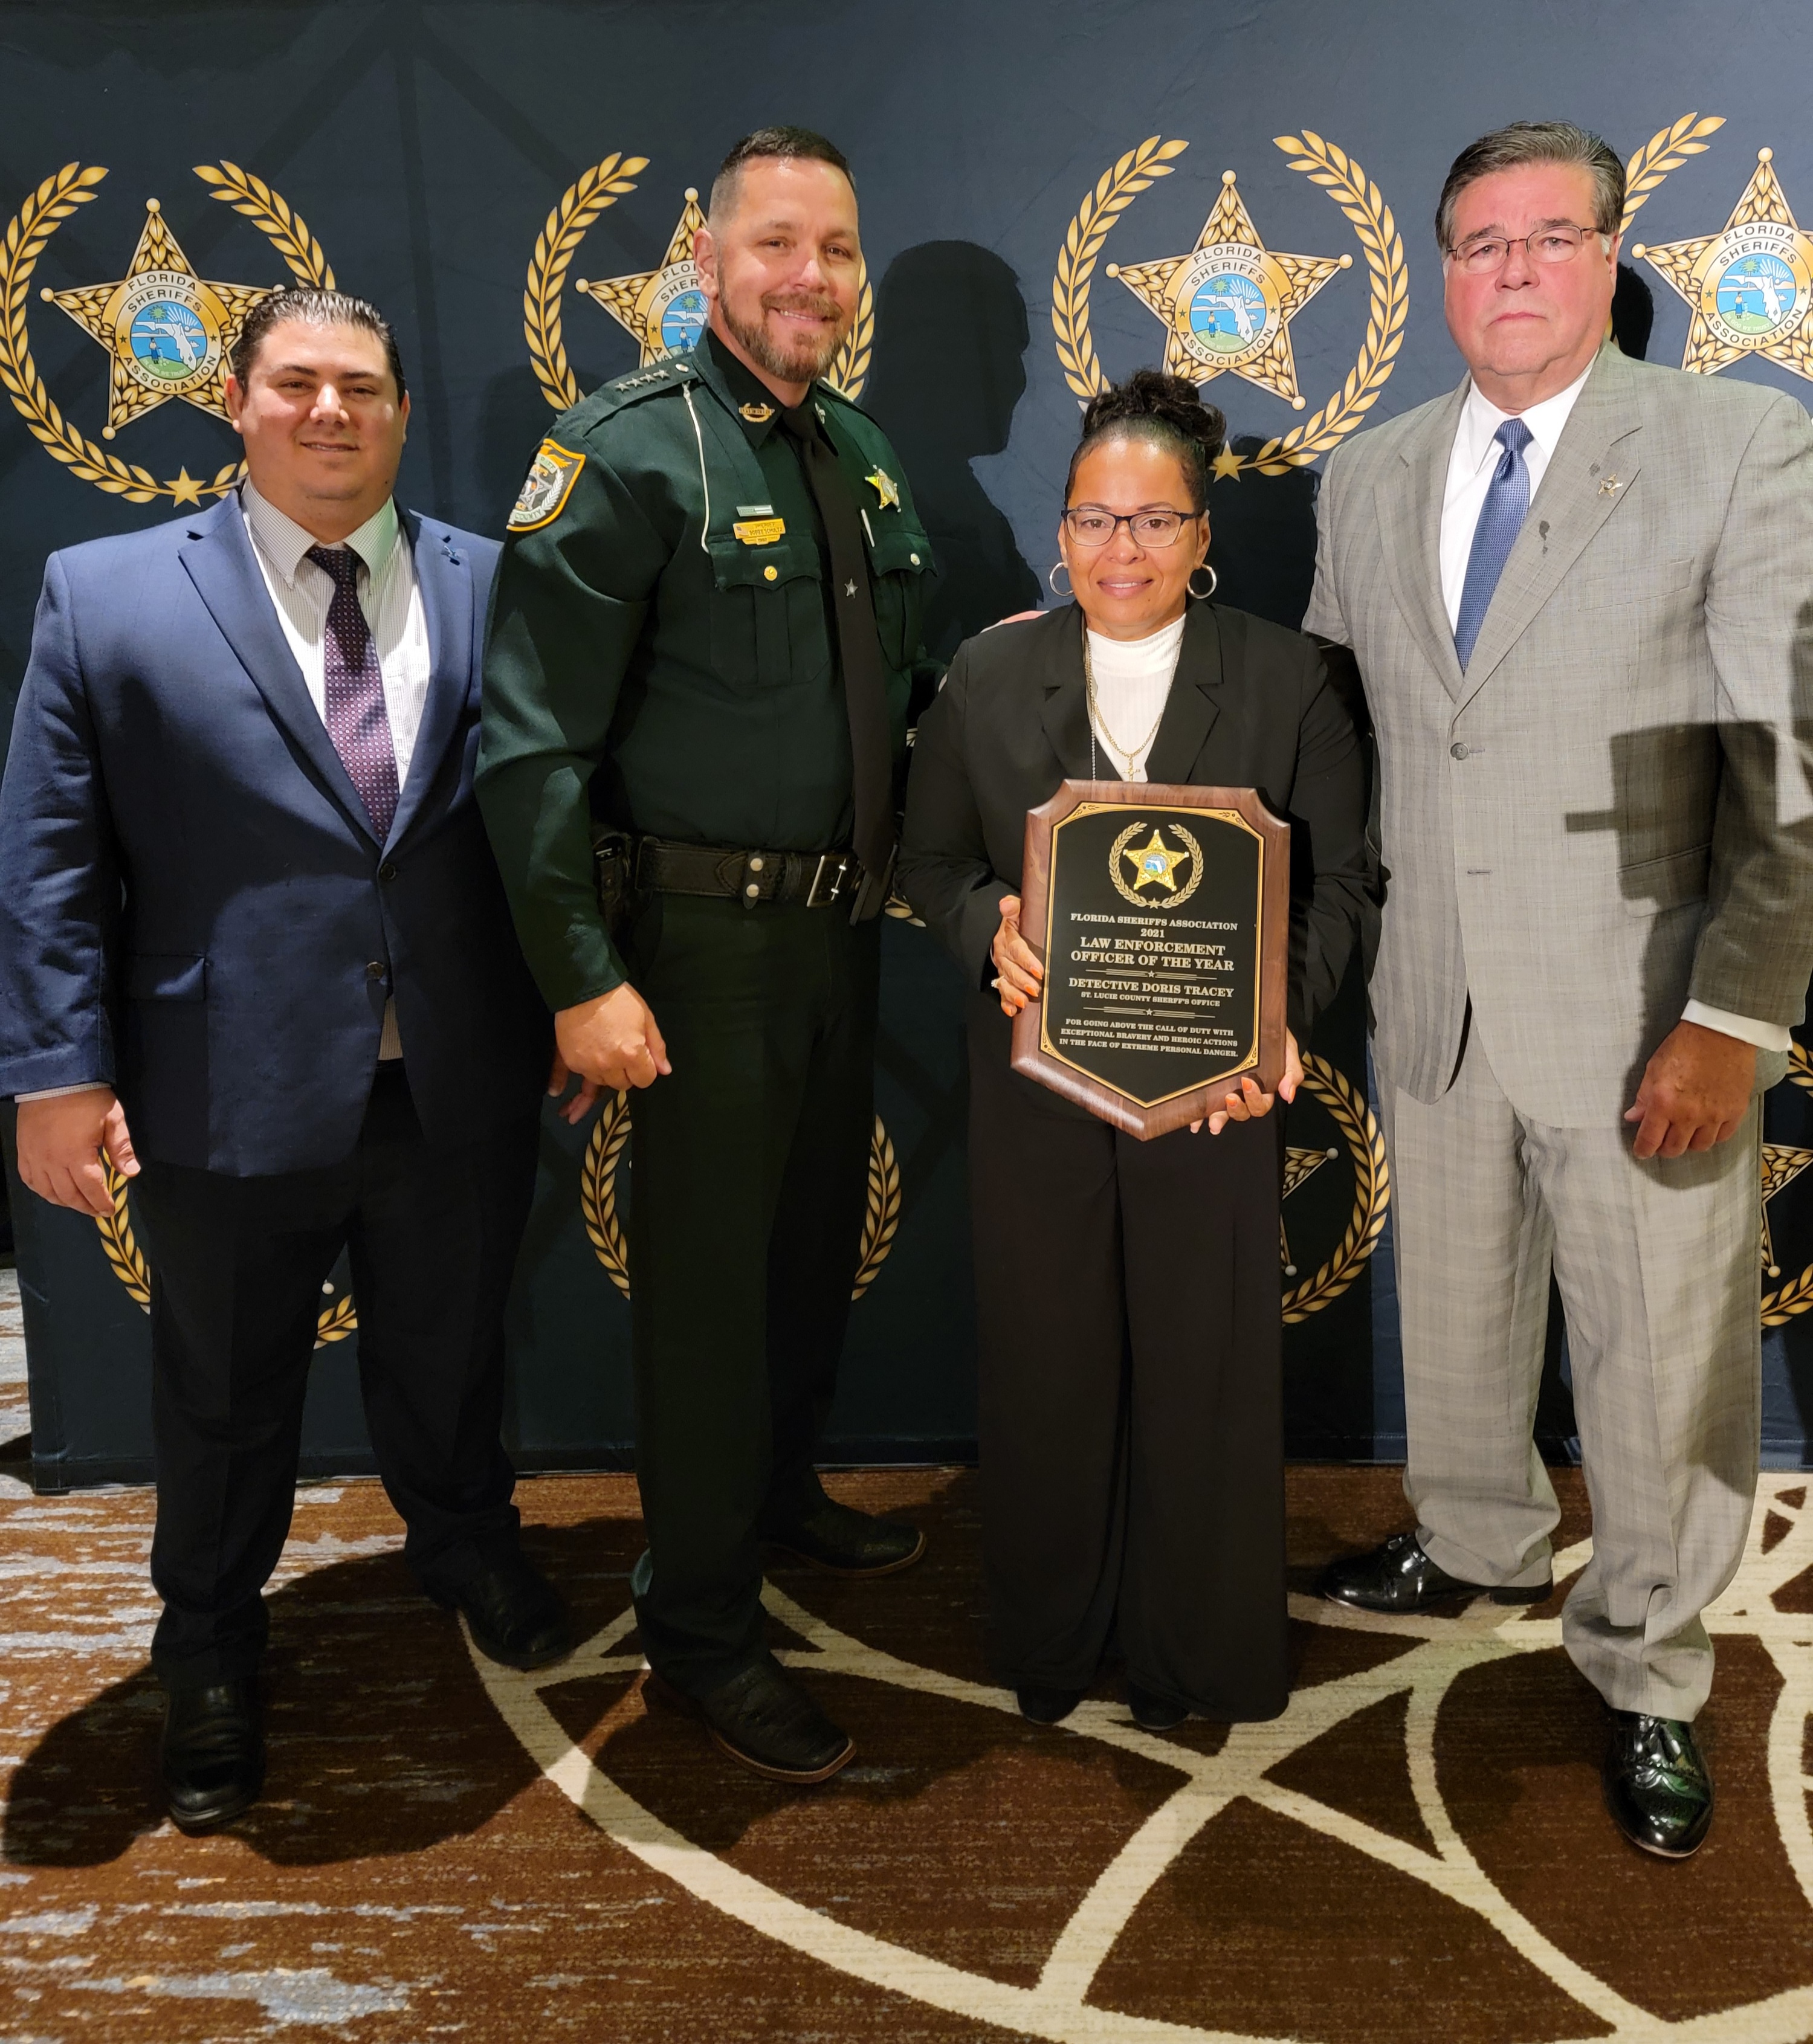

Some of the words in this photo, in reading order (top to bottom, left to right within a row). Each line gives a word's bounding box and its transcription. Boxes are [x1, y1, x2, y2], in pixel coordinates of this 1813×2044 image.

[1724, 225, 1795, 244] FLORIDA
[1194, 246, 1262, 264] FLORIDA
[1720, 241, 1797, 266] SHERIFFS
[128, 274, 196, 291] FLORIDA
[1191, 262, 1265, 286] SHERIFFS
[128, 289, 202, 312] SHERIFFS
[661, 279, 699, 303] SHER
[1706, 309, 1802, 347] ASSOCIATION
[1730, 320, 1742, 328] GOD
[1753, 323, 1769, 331] TRUST
[1180, 328, 1273, 366] ASSOCIATION
[124, 355, 216, 392] ASSOCIATION
[514, 509, 542, 521] COUNTY
[1070, 913, 1116, 923] FLORIDA
[1117, 916, 1167, 926] SHERIFFS
[1169, 919, 1238, 930] ASSOCIATION
[1140, 928, 1165, 938] 2021
[1080, 937, 1111, 949] LAW
[1114, 939, 1226, 956] ENFORCEMENT
[1071, 950, 1135, 965] OFFICER
[1138, 955, 1158, 966] OF
[1161, 956, 1191, 968] THE
[1194, 958, 1235, 971] YEAR
[1068, 978, 1139, 991] DETECTIVE
[1142, 982, 1181, 994] DORIS
[1184, 985, 1234, 998] TRACEY
[1191, 999, 1220, 1007] OFFICE
[1061, 1028, 1115, 1038] EXCEPTIONAL
[1116, 1032, 1152, 1041] BRAVERY
[1171, 1036, 1202, 1045] HEROIC
[1203, 1039, 1238, 1047] ACTIONS
[1121, 1043, 1159, 1051] EXTREME
[1160, 1045, 1202, 1054] PERSONAL
[1203, 1048, 1238, 1057] DANGER.
